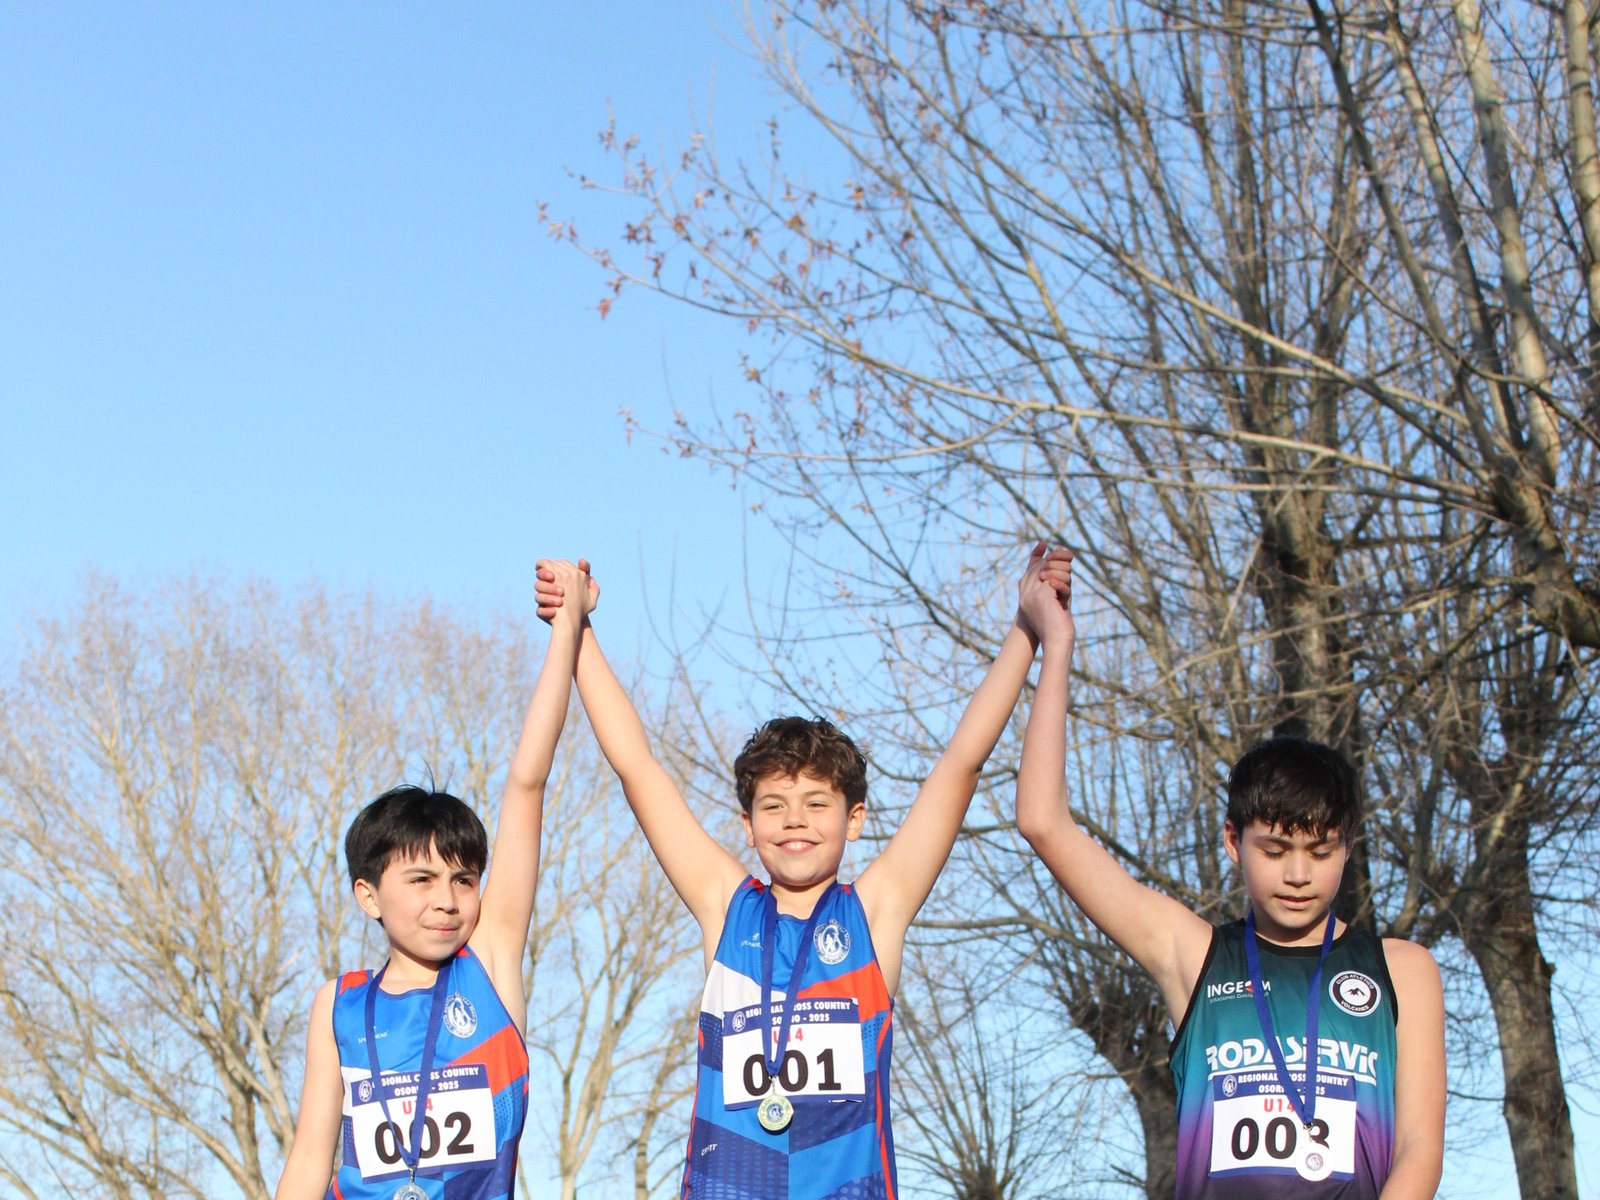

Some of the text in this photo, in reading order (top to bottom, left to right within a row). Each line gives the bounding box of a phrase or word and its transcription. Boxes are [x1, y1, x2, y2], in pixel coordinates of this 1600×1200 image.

[746, 1003, 784, 1018] REGIAL
[814, 1001, 851, 1011] COUNTRY
[809, 1013, 830, 1023] 2025
[442, 1066, 480, 1080] COUNTRY
[742, 1048, 842, 1097] 001
[1238, 1072, 1279, 1084] REGIONAL
[1316, 1074, 1350, 1087] OUNTRY
[438, 1080, 460, 1091] 2025
[1258, 1084, 1285, 1094] OSOR
[374, 1111, 475, 1165] 002
